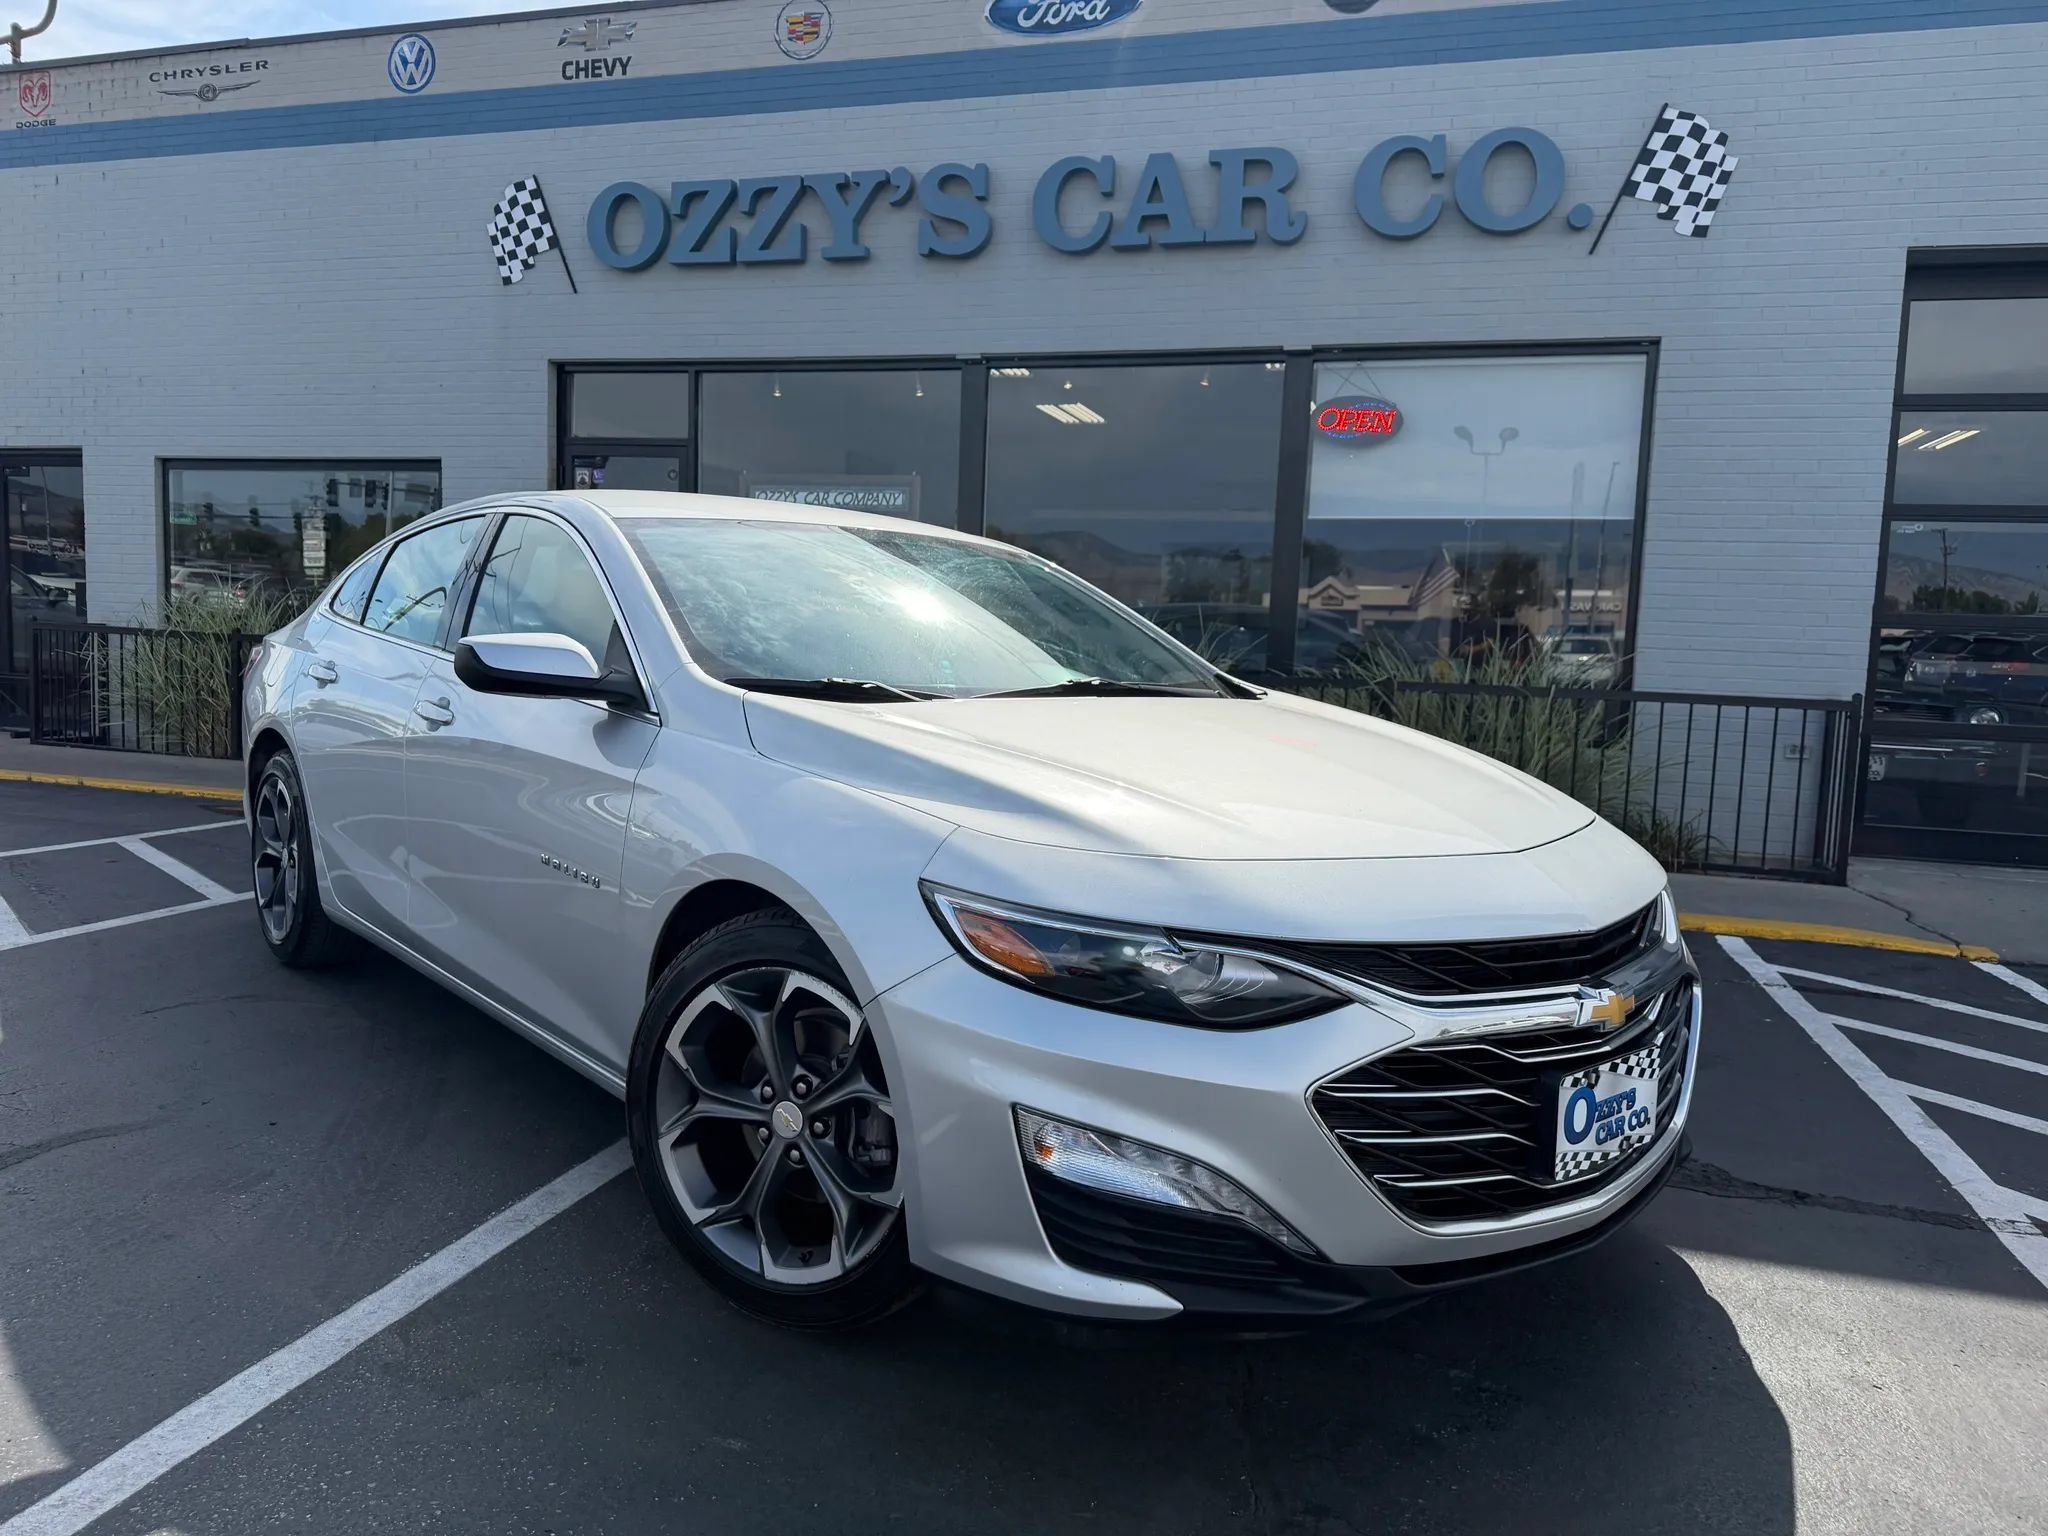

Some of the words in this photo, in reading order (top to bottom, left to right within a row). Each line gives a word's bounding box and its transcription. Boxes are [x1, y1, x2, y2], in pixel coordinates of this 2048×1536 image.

[1017, 0, 1110, 28] Ford
[149, 60, 269, 83] CHRYSLER
[561, 56, 632, 81] CHEVY
[16, 118, 56, 129] DODGE
[586, 163, 993, 271] OZZY'S
[1032, 146, 1307, 254] CAR
[1354, 127, 1594, 240] CO.
[1317, 407, 1396, 433] OPEN
[804, 491, 830, 506] CAR
[833, 491, 902, 506] COMPANY
[1595, 1115, 1626, 1146] CAR
[1628, 1106, 1651, 1132] CO.
